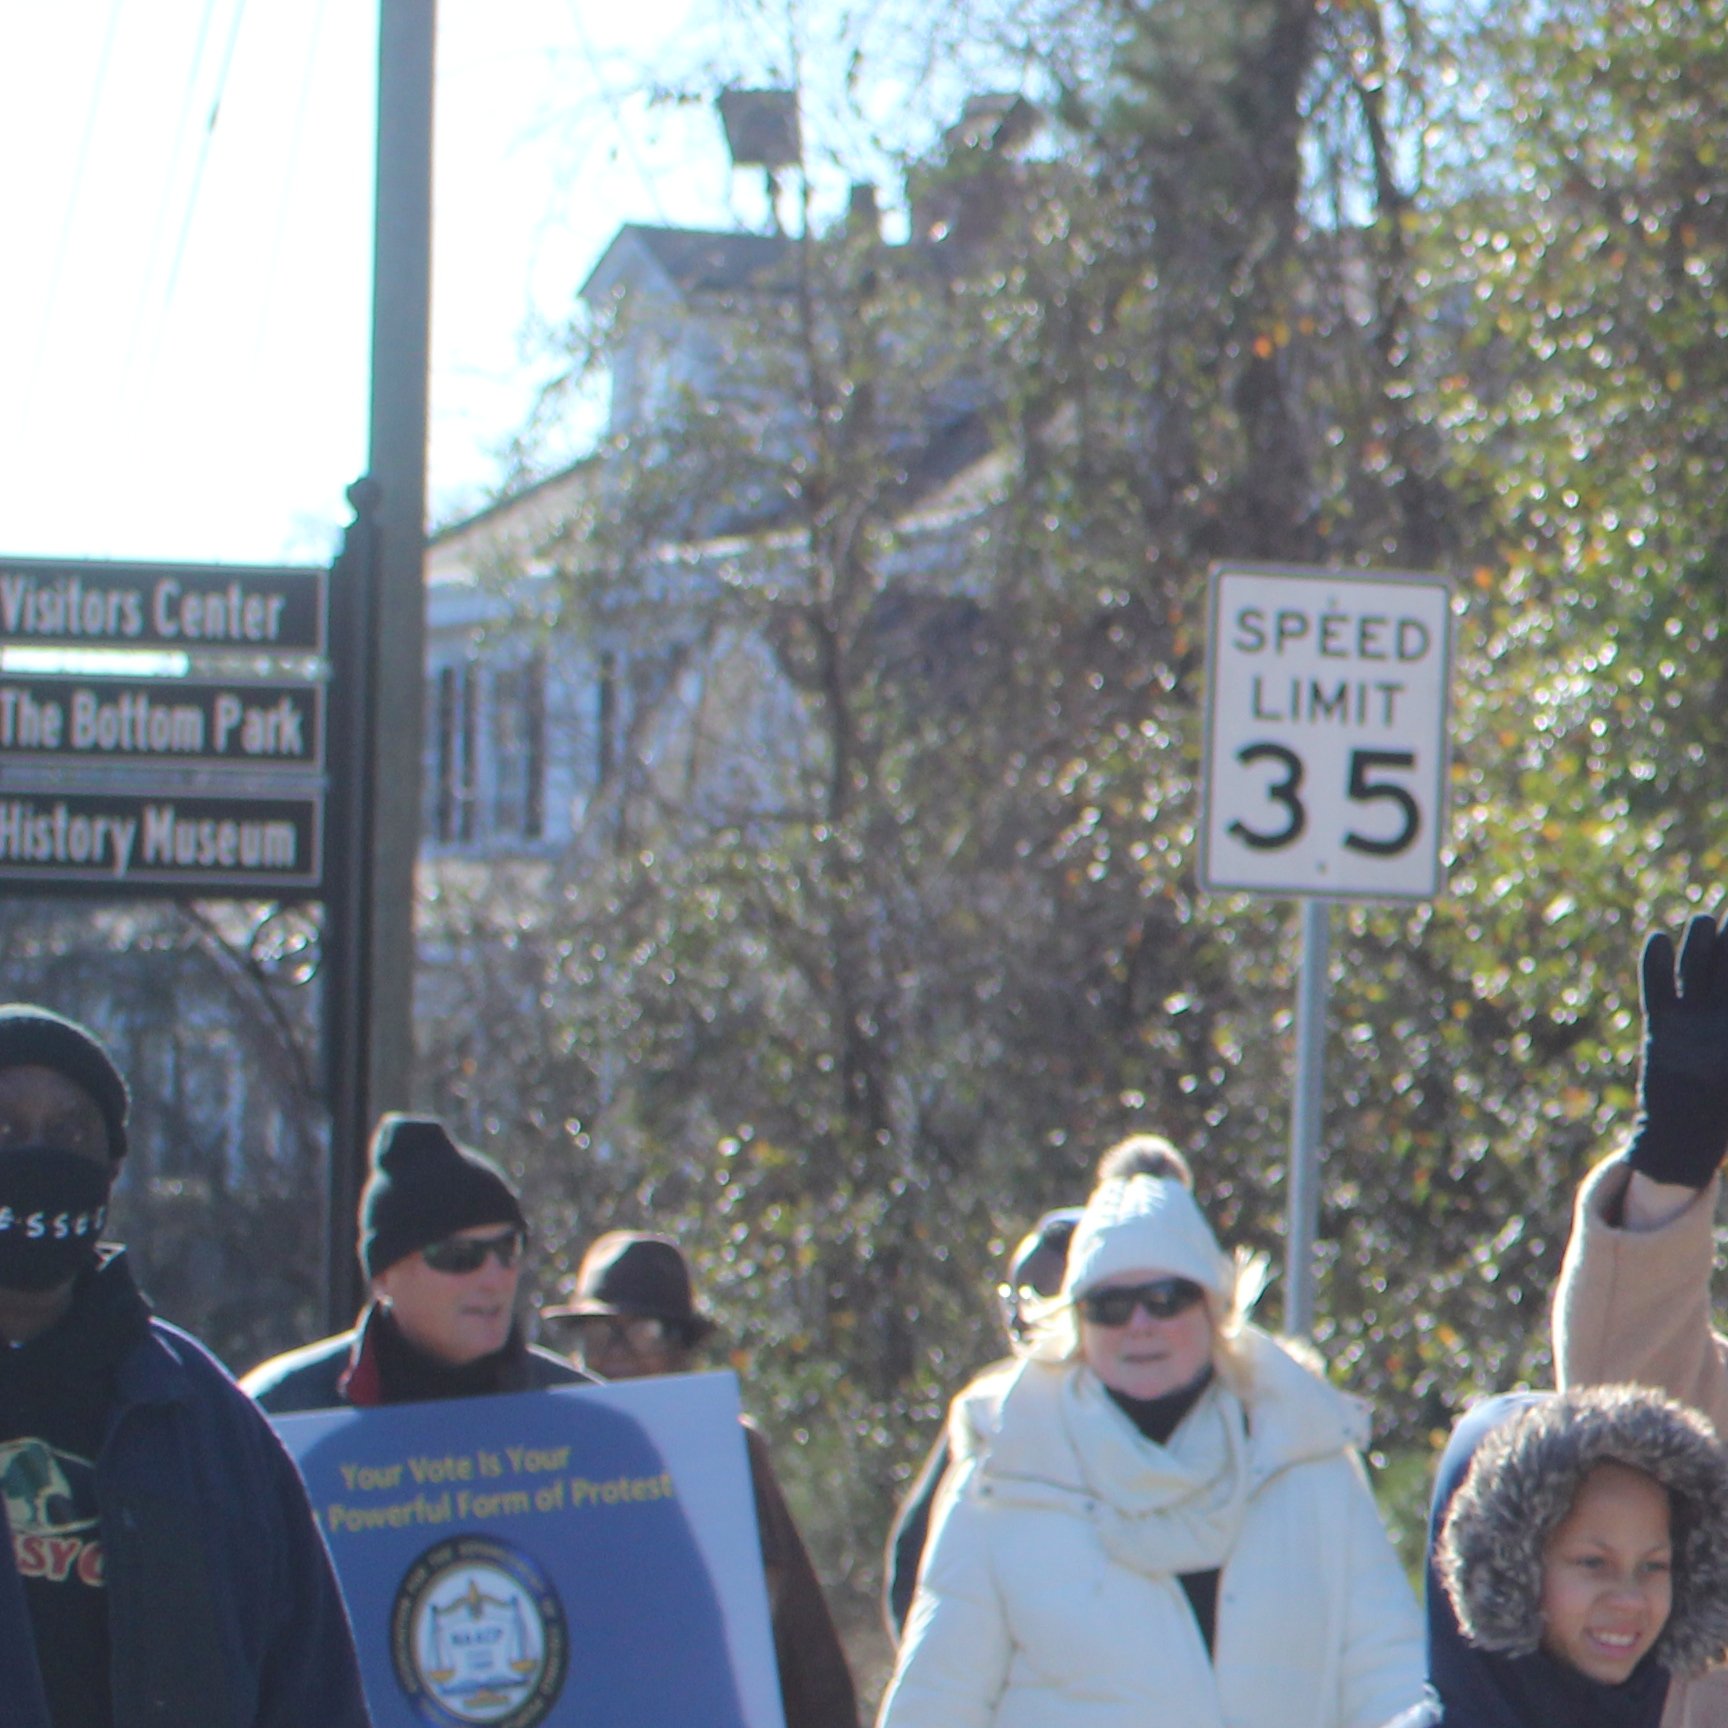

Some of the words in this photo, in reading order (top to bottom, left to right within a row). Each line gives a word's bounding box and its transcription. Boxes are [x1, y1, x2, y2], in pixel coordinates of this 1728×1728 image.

[0, 575, 143, 638] Visitors
[152, 577, 286, 641] Center
[1235, 607, 1429, 662] SPEED
[0, 688, 63, 750] The
[71, 690, 205, 752] Bottom
[214, 692, 303, 756] Park
[1252, 676, 1403, 727] LIMIT
[1227, 744, 1421, 857] 35
[0, 801, 137, 879] History
[142, 804, 297, 868] Museum
[340, 1463, 402, 1490] Your
[408, 1456, 473, 1484] Vote
[477, 1450, 502, 1477] Is
[505, 1445, 571, 1473] Your
[327, 1492, 451, 1533] Powerful
[456, 1489, 530, 1519] Form
[535, 1480, 565, 1512] of
[571, 1472, 674, 1507] Protest
